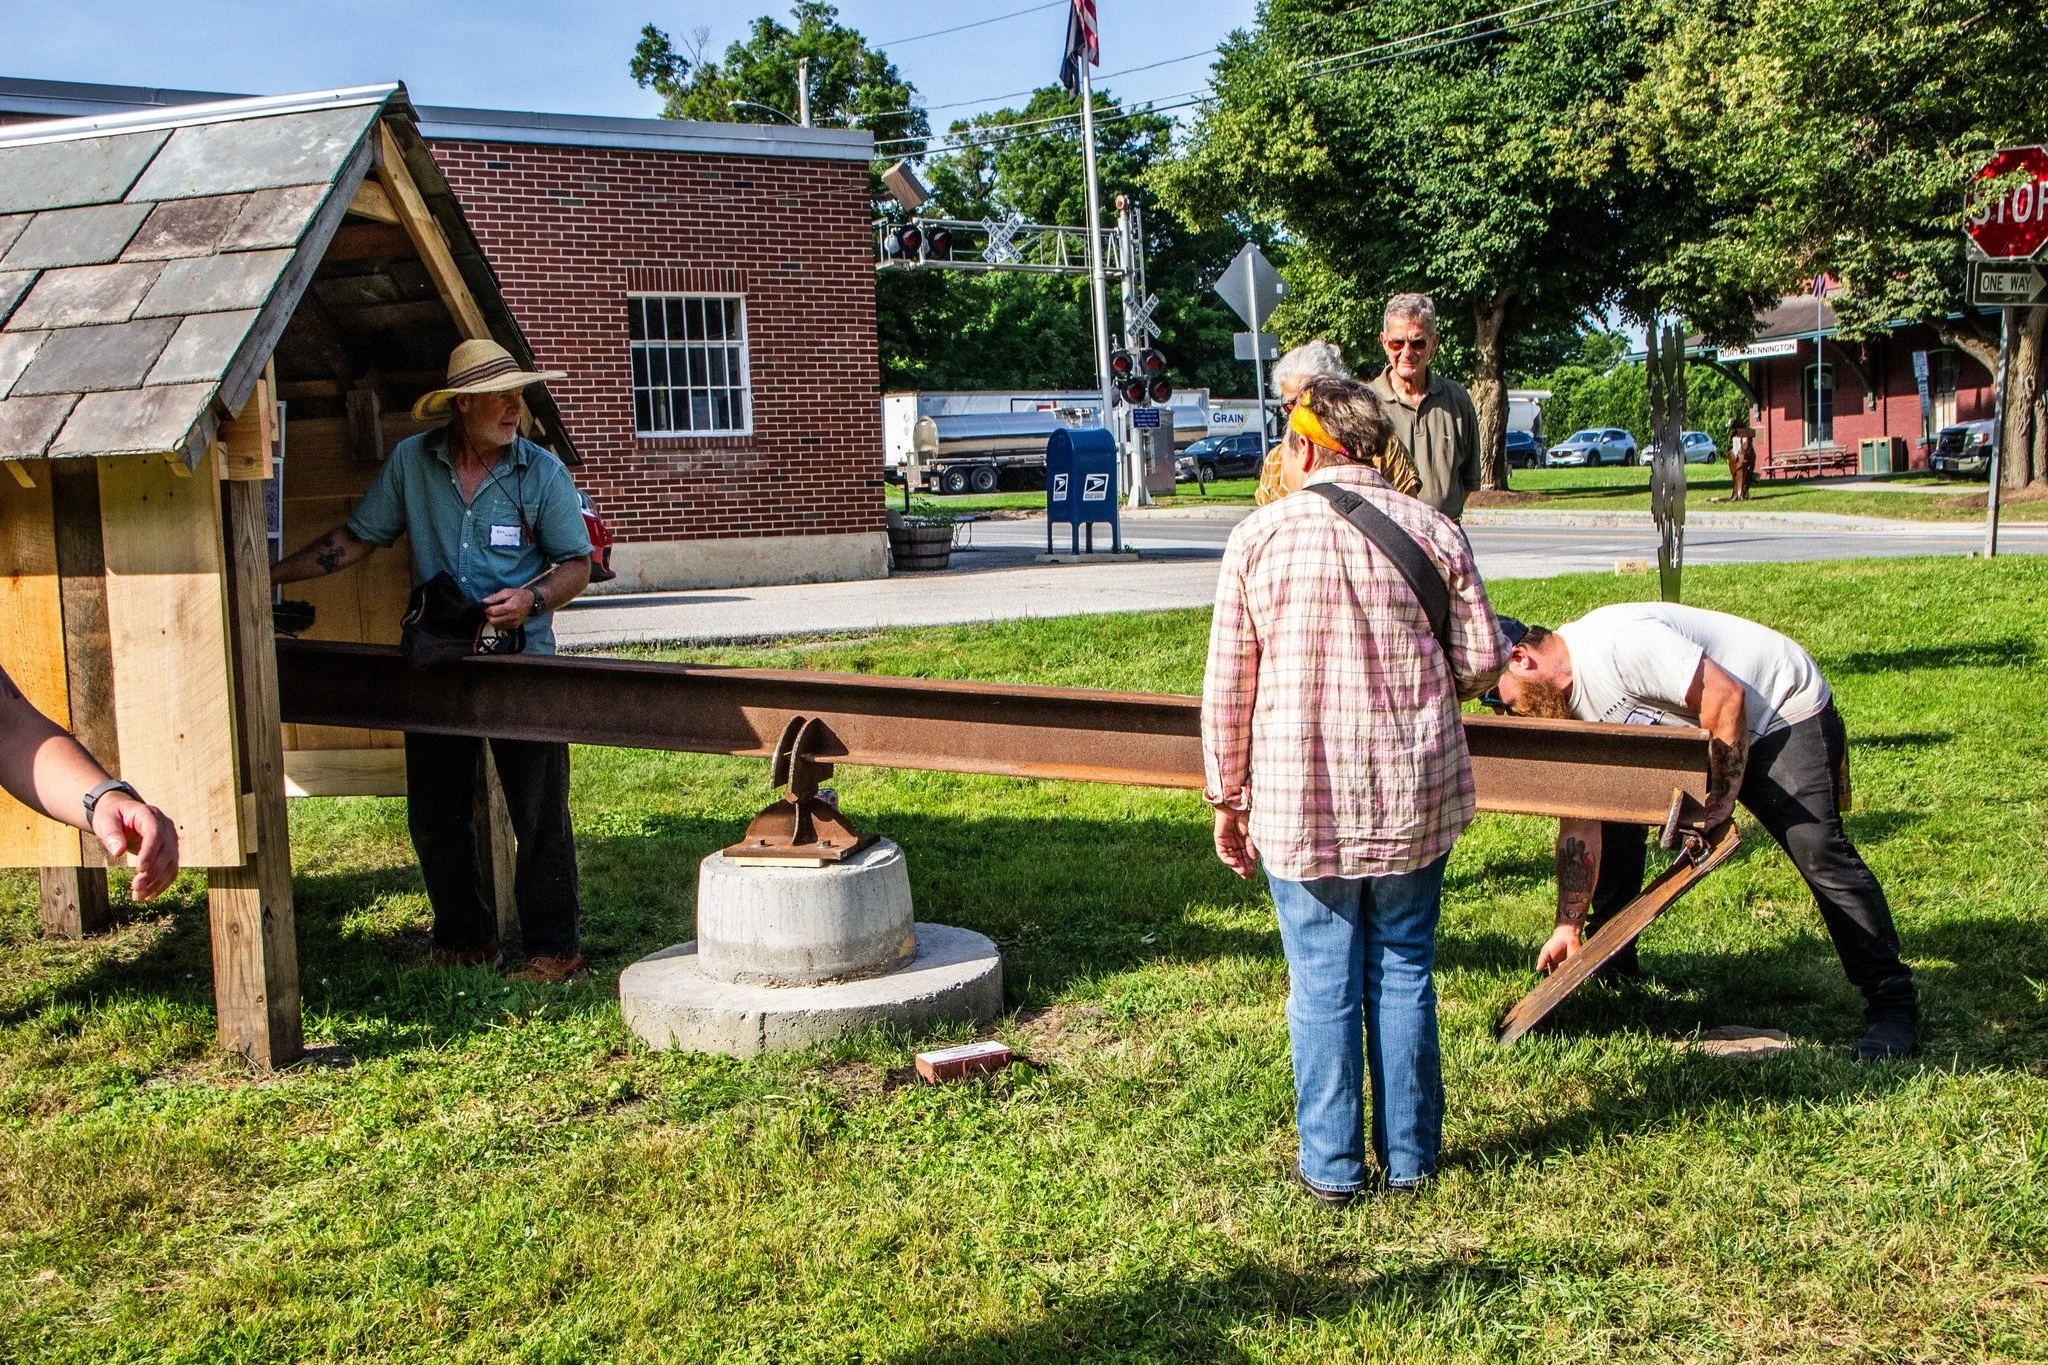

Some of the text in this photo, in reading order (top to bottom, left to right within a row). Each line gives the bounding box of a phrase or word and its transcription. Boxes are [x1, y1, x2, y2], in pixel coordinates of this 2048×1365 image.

[983, 218, 1020, 261] RAIL ROAD
[985, 219, 1020, 260] CROSSING
[1983, 275, 2032, 291] ONE WAY
[1126, 296, 1159, 337] RAIL ROAD
[1129, 296, 1157, 336] CROSSING
[1720, 343, 1795, 358] NORT BENNINGTON
[1213, 412, 1244, 423] GRAIN
